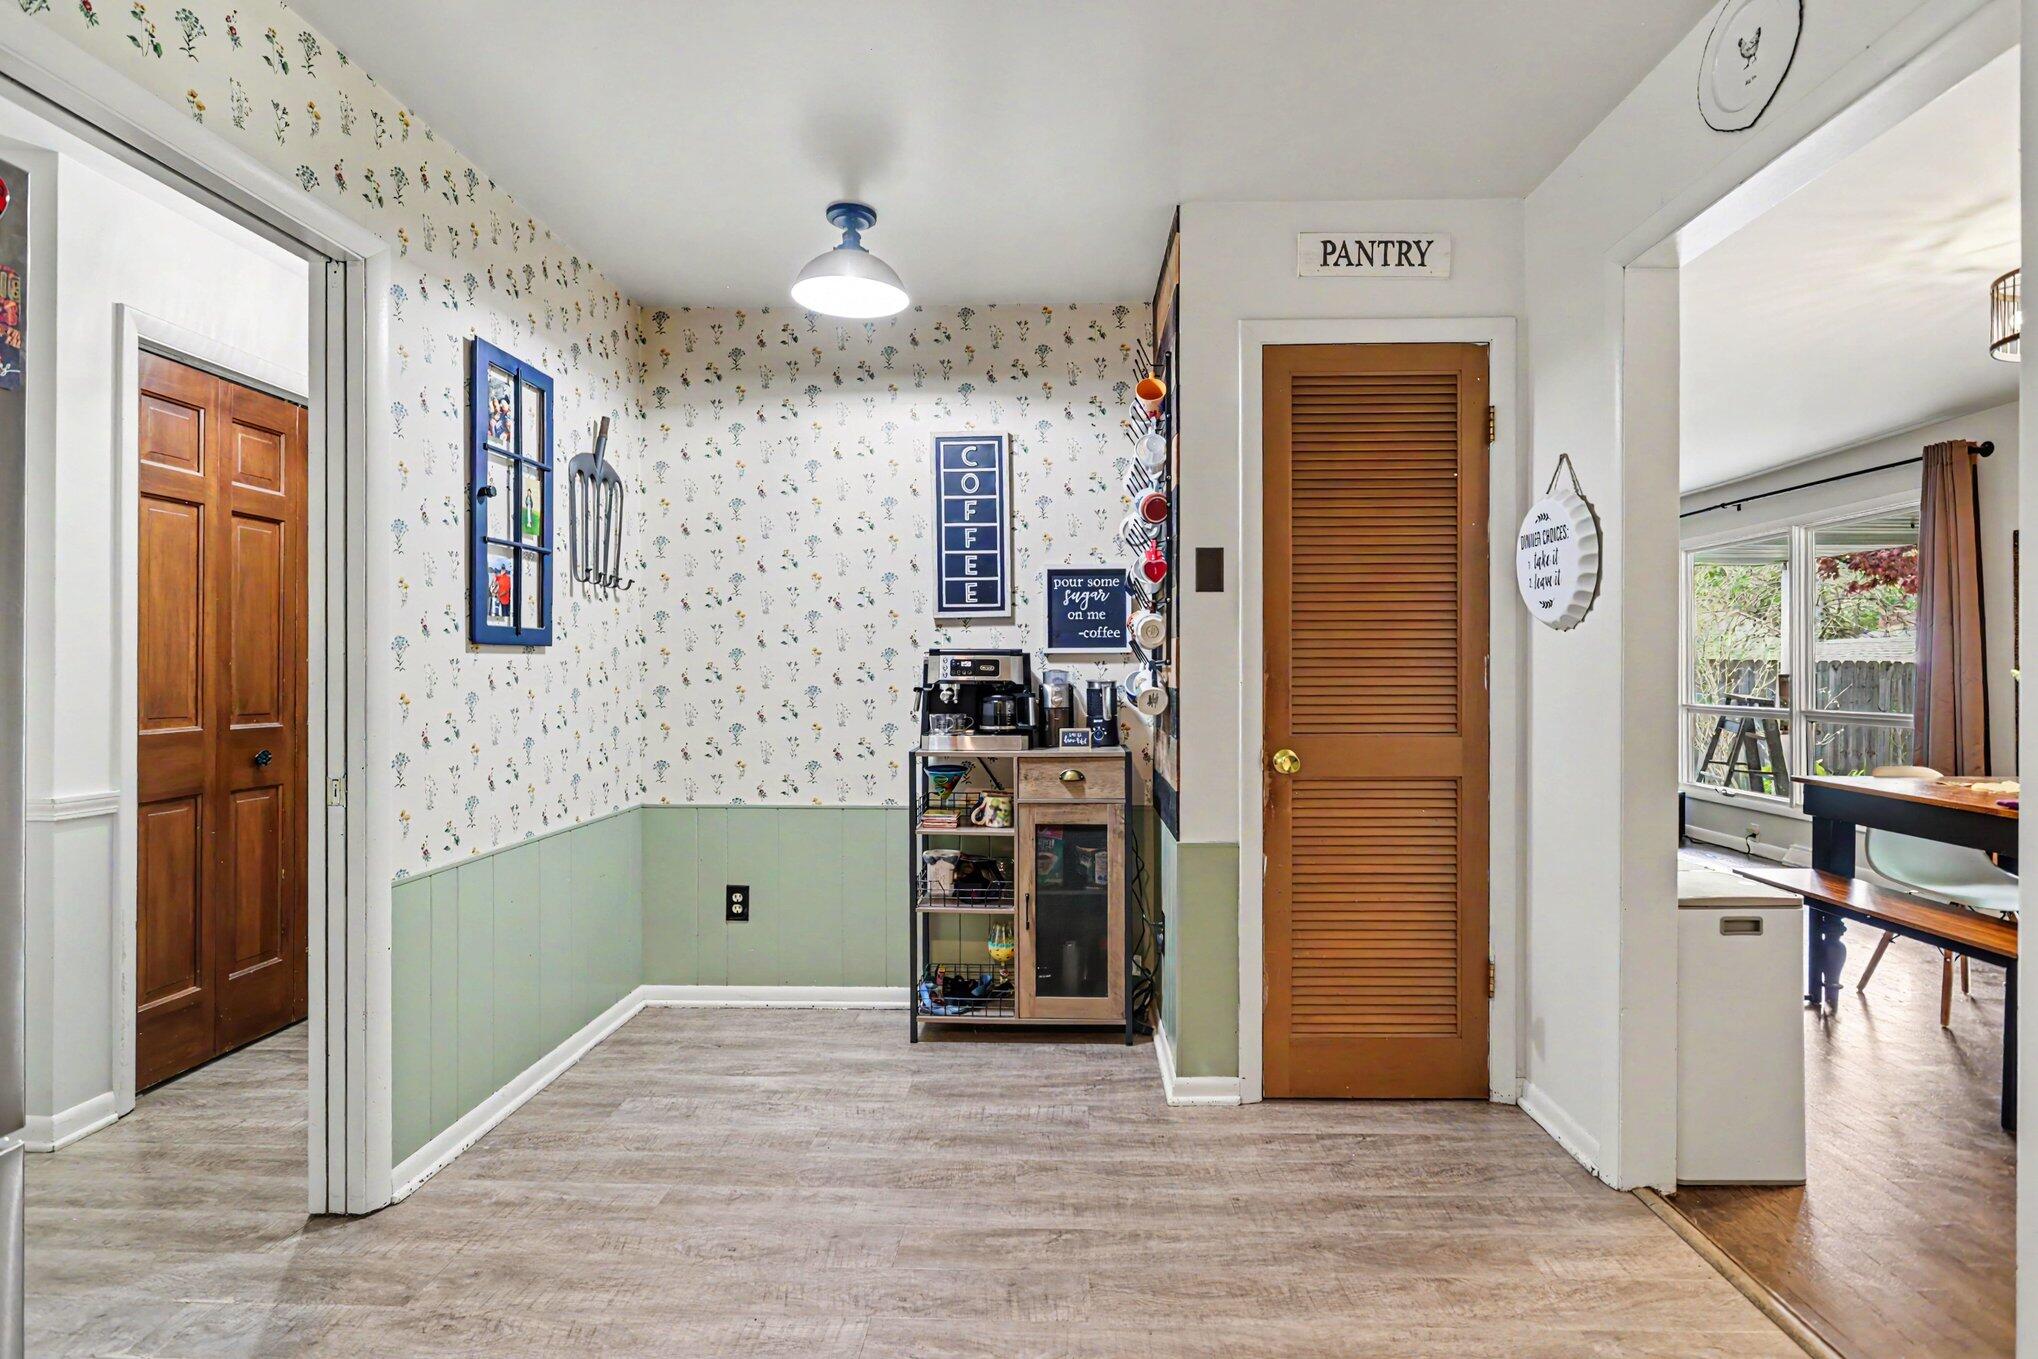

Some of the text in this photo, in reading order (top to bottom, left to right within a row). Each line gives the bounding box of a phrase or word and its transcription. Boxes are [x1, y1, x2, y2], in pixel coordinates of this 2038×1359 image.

[1320, 239, 1434, 268] PANTRY
[960, 445, 980, 604] COFFEE
[1520, 531, 1541, 551] DINNER
[1533, 551, 1550, 570] take
[1552, 547, 1559, 566] it
[1053, 577, 1120, 590] pour some
[1534, 573, 1553, 590] leave
[1554, 568, 1561, 586] it
[1063, 588, 1110, 611] sugar
[1067, 610, 1106, 620] on me
[1078, 626, 1121, 639] -coffee
